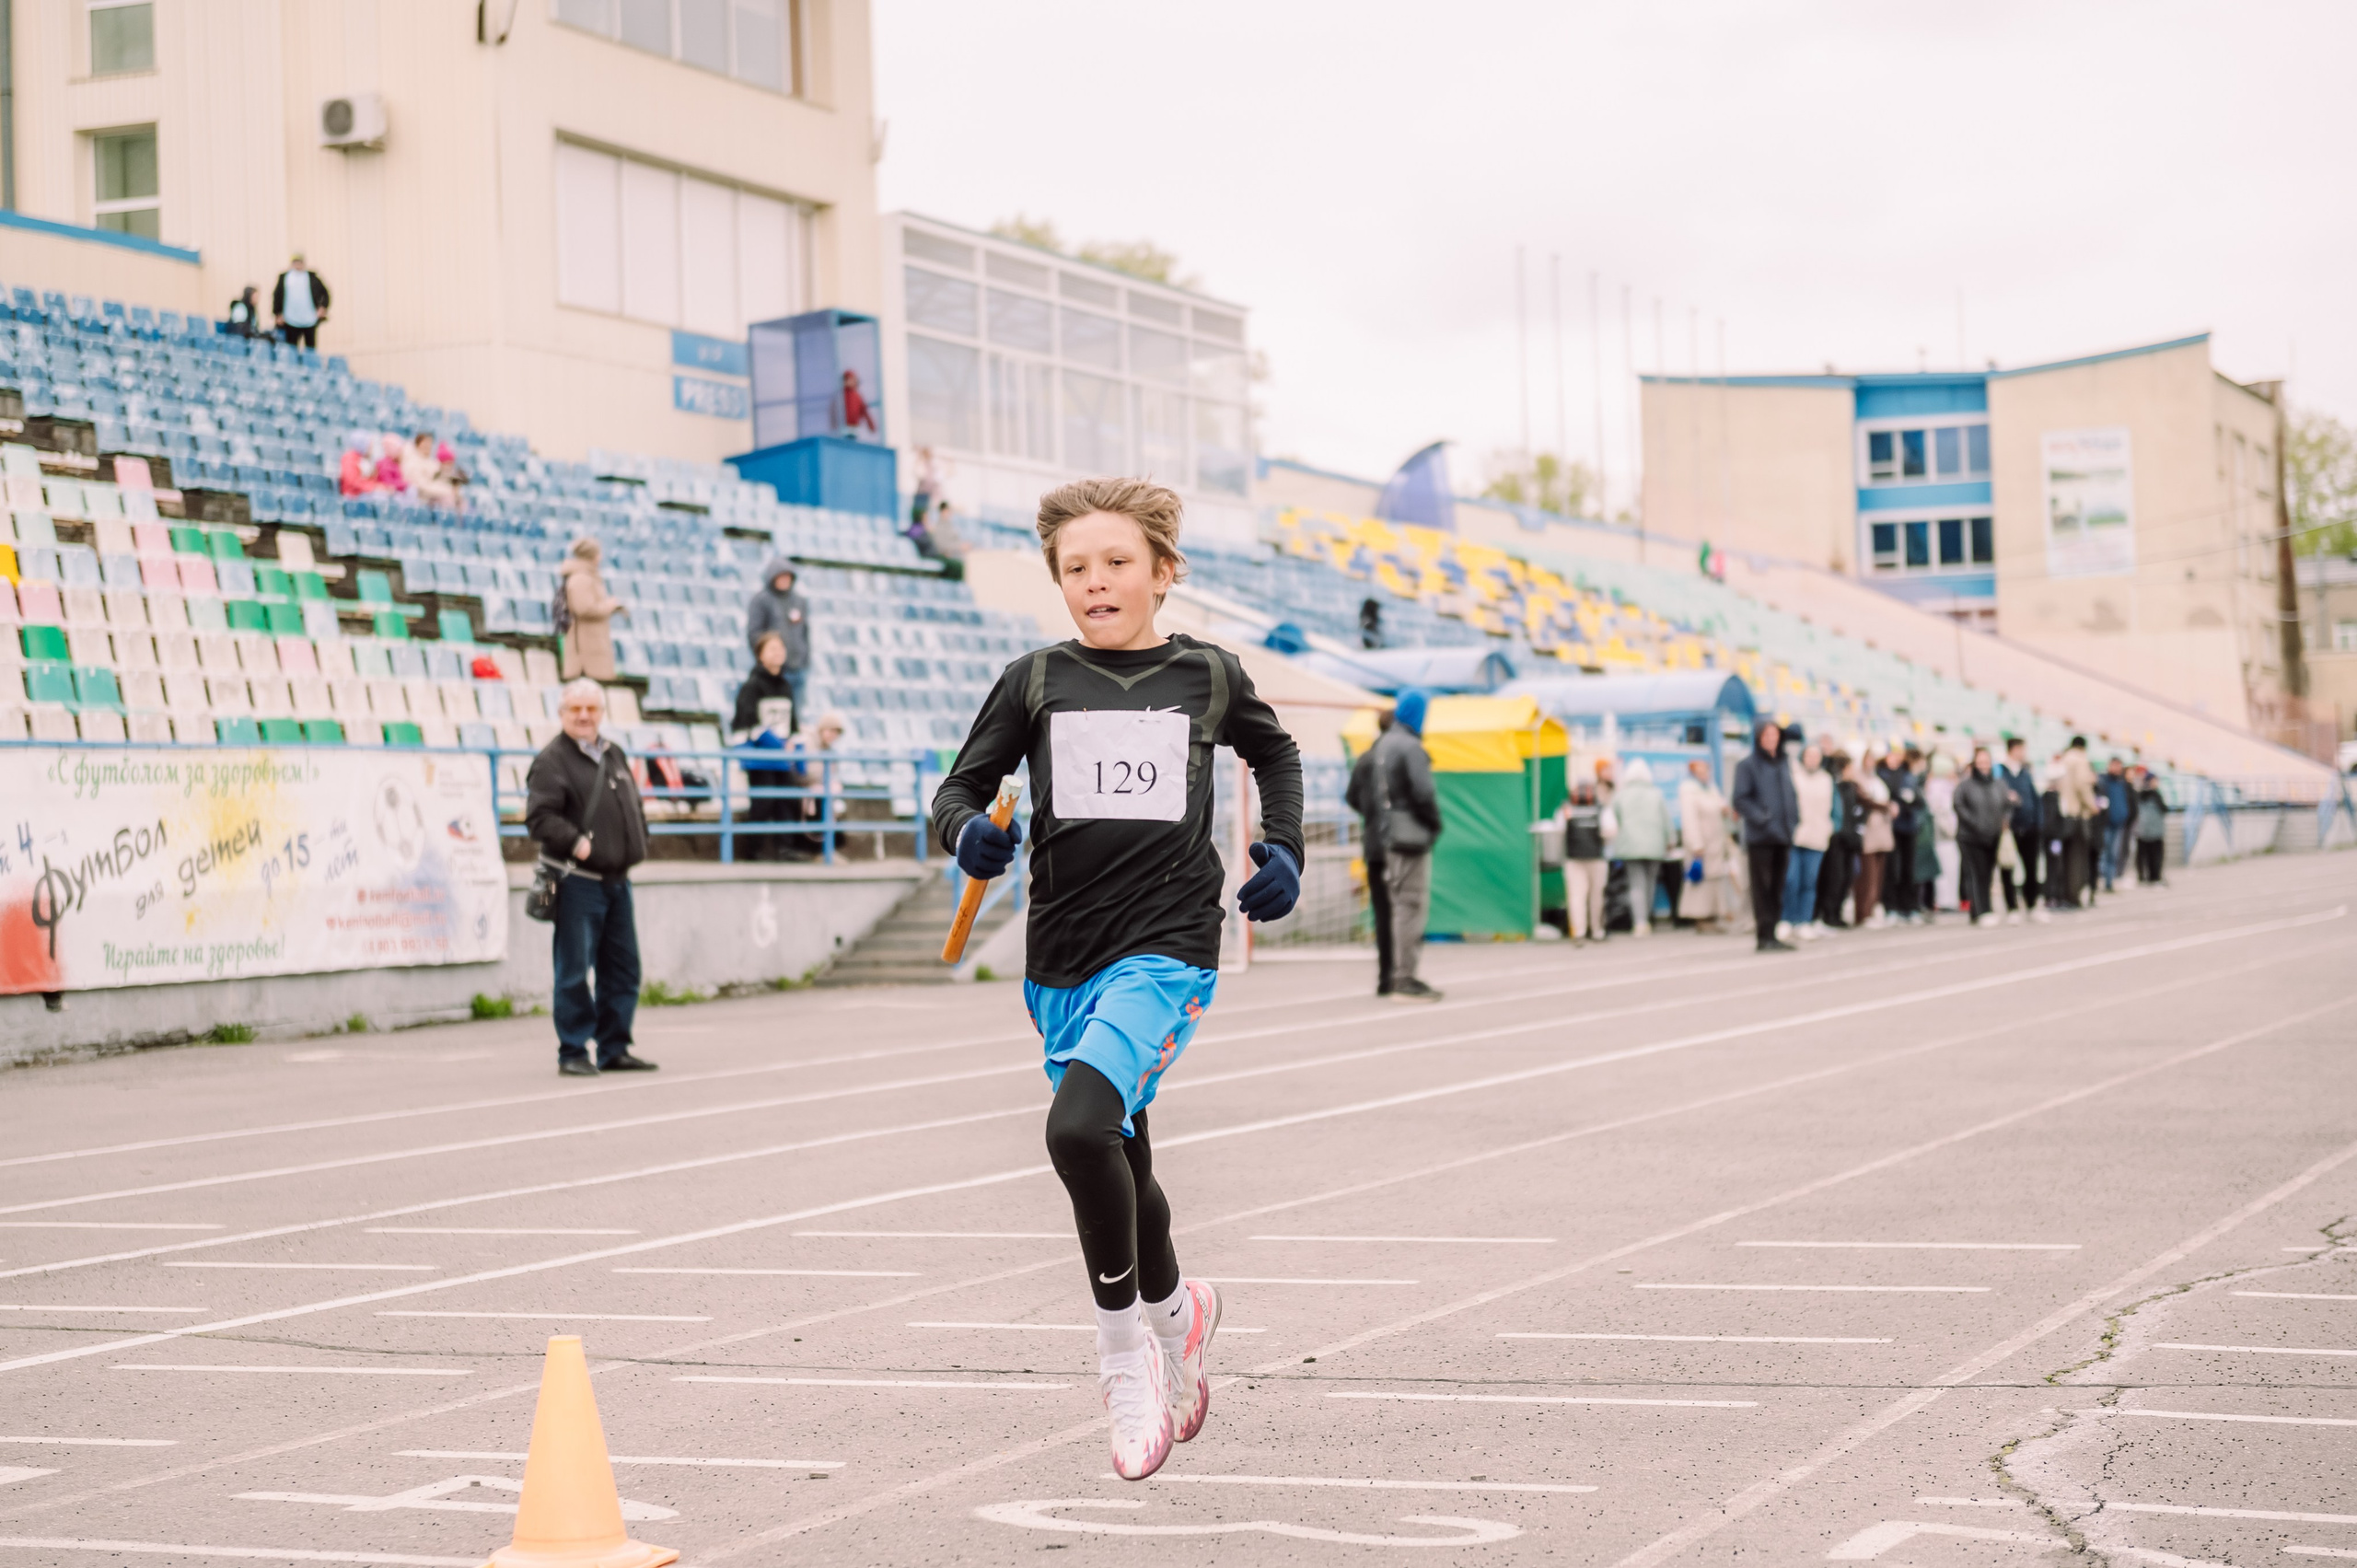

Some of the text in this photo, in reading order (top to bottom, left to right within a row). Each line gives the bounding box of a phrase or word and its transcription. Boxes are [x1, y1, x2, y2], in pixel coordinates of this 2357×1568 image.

[74, 751, 178, 799] футболом
[184, 763, 204, 798] за
[1093, 761, 1157, 795] 129
[135, 818, 262, 921] для детей
[261, 856, 281, 900] до
[103, 934, 286, 982] Играйте на здоровье!
